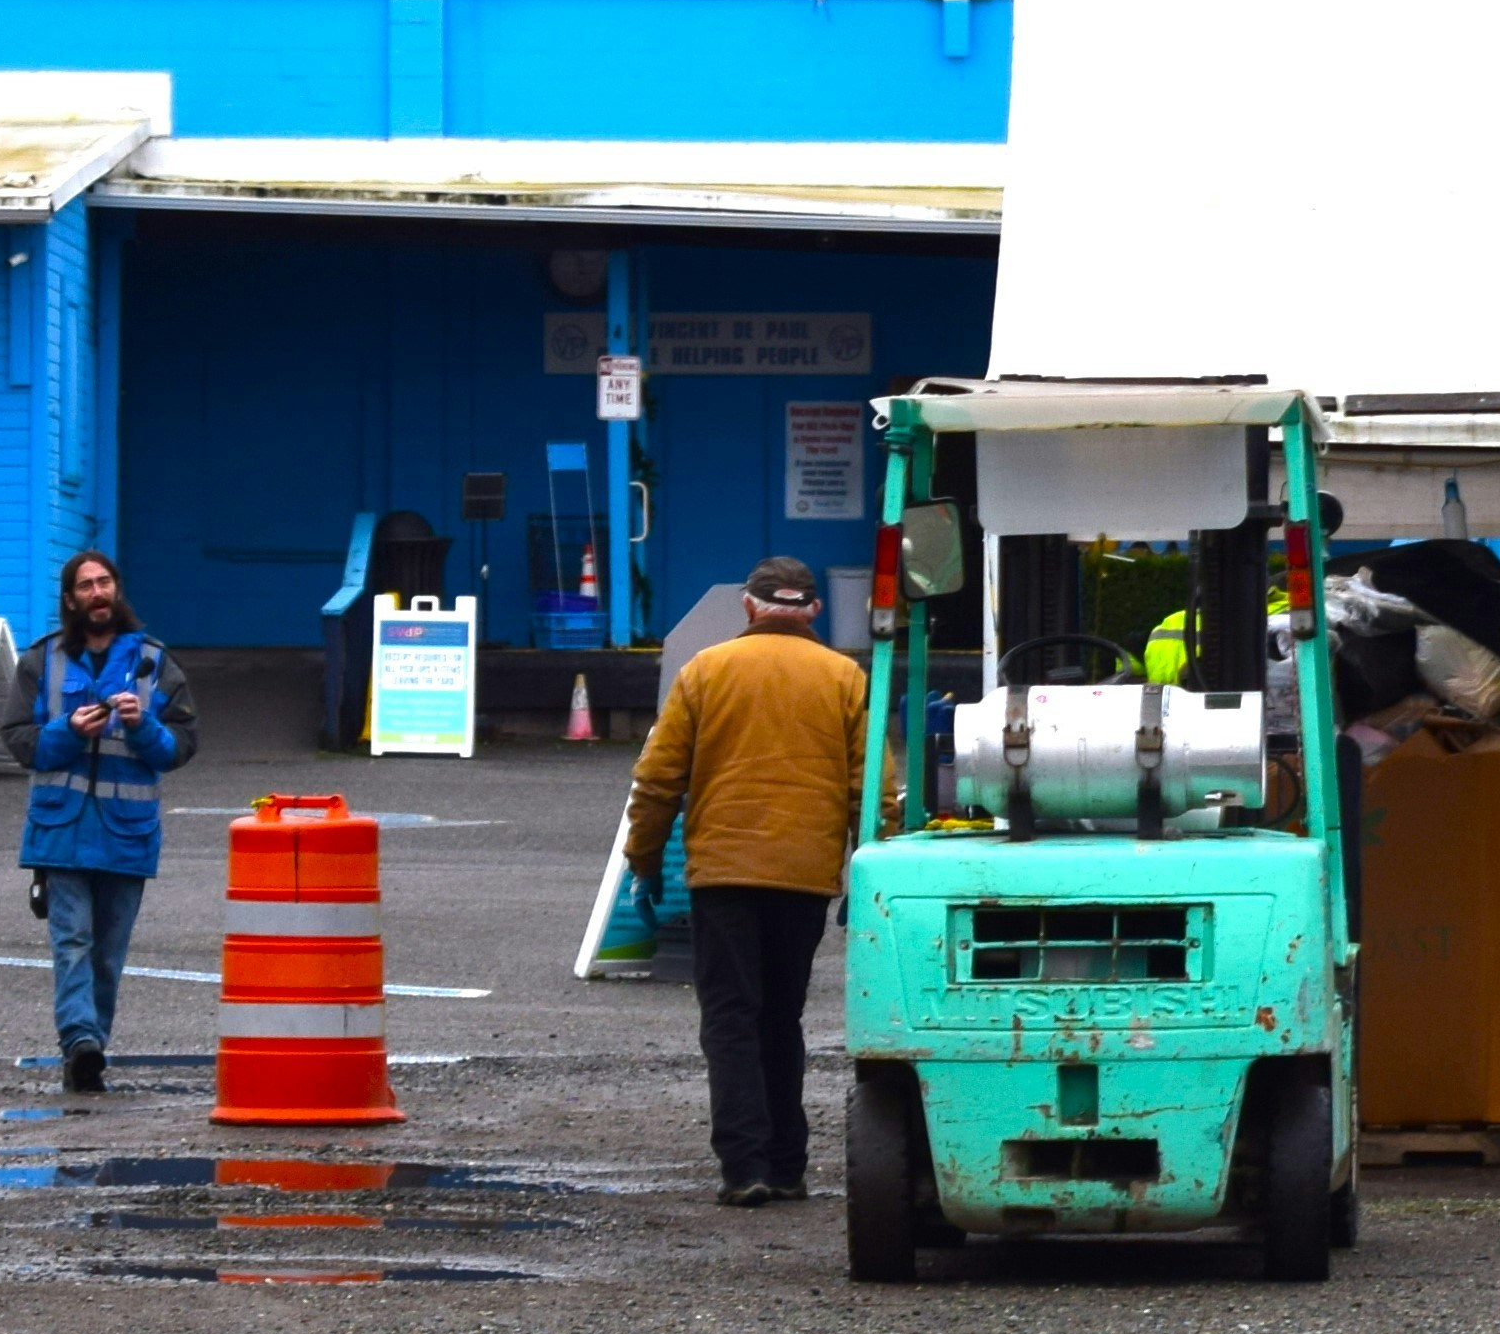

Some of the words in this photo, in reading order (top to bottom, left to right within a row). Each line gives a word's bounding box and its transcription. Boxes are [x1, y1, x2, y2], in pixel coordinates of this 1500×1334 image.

[732, 320, 753, 339] DE
[765, 320, 810, 339] PAUL
[671, 346, 743, 365] HELPING
[757, 346, 819, 365] PEOPLE
[607, 378, 630, 390] ANY
[606, 392, 632, 405] TIME
[918, 985, 1244, 1024] MITSUBISHI
